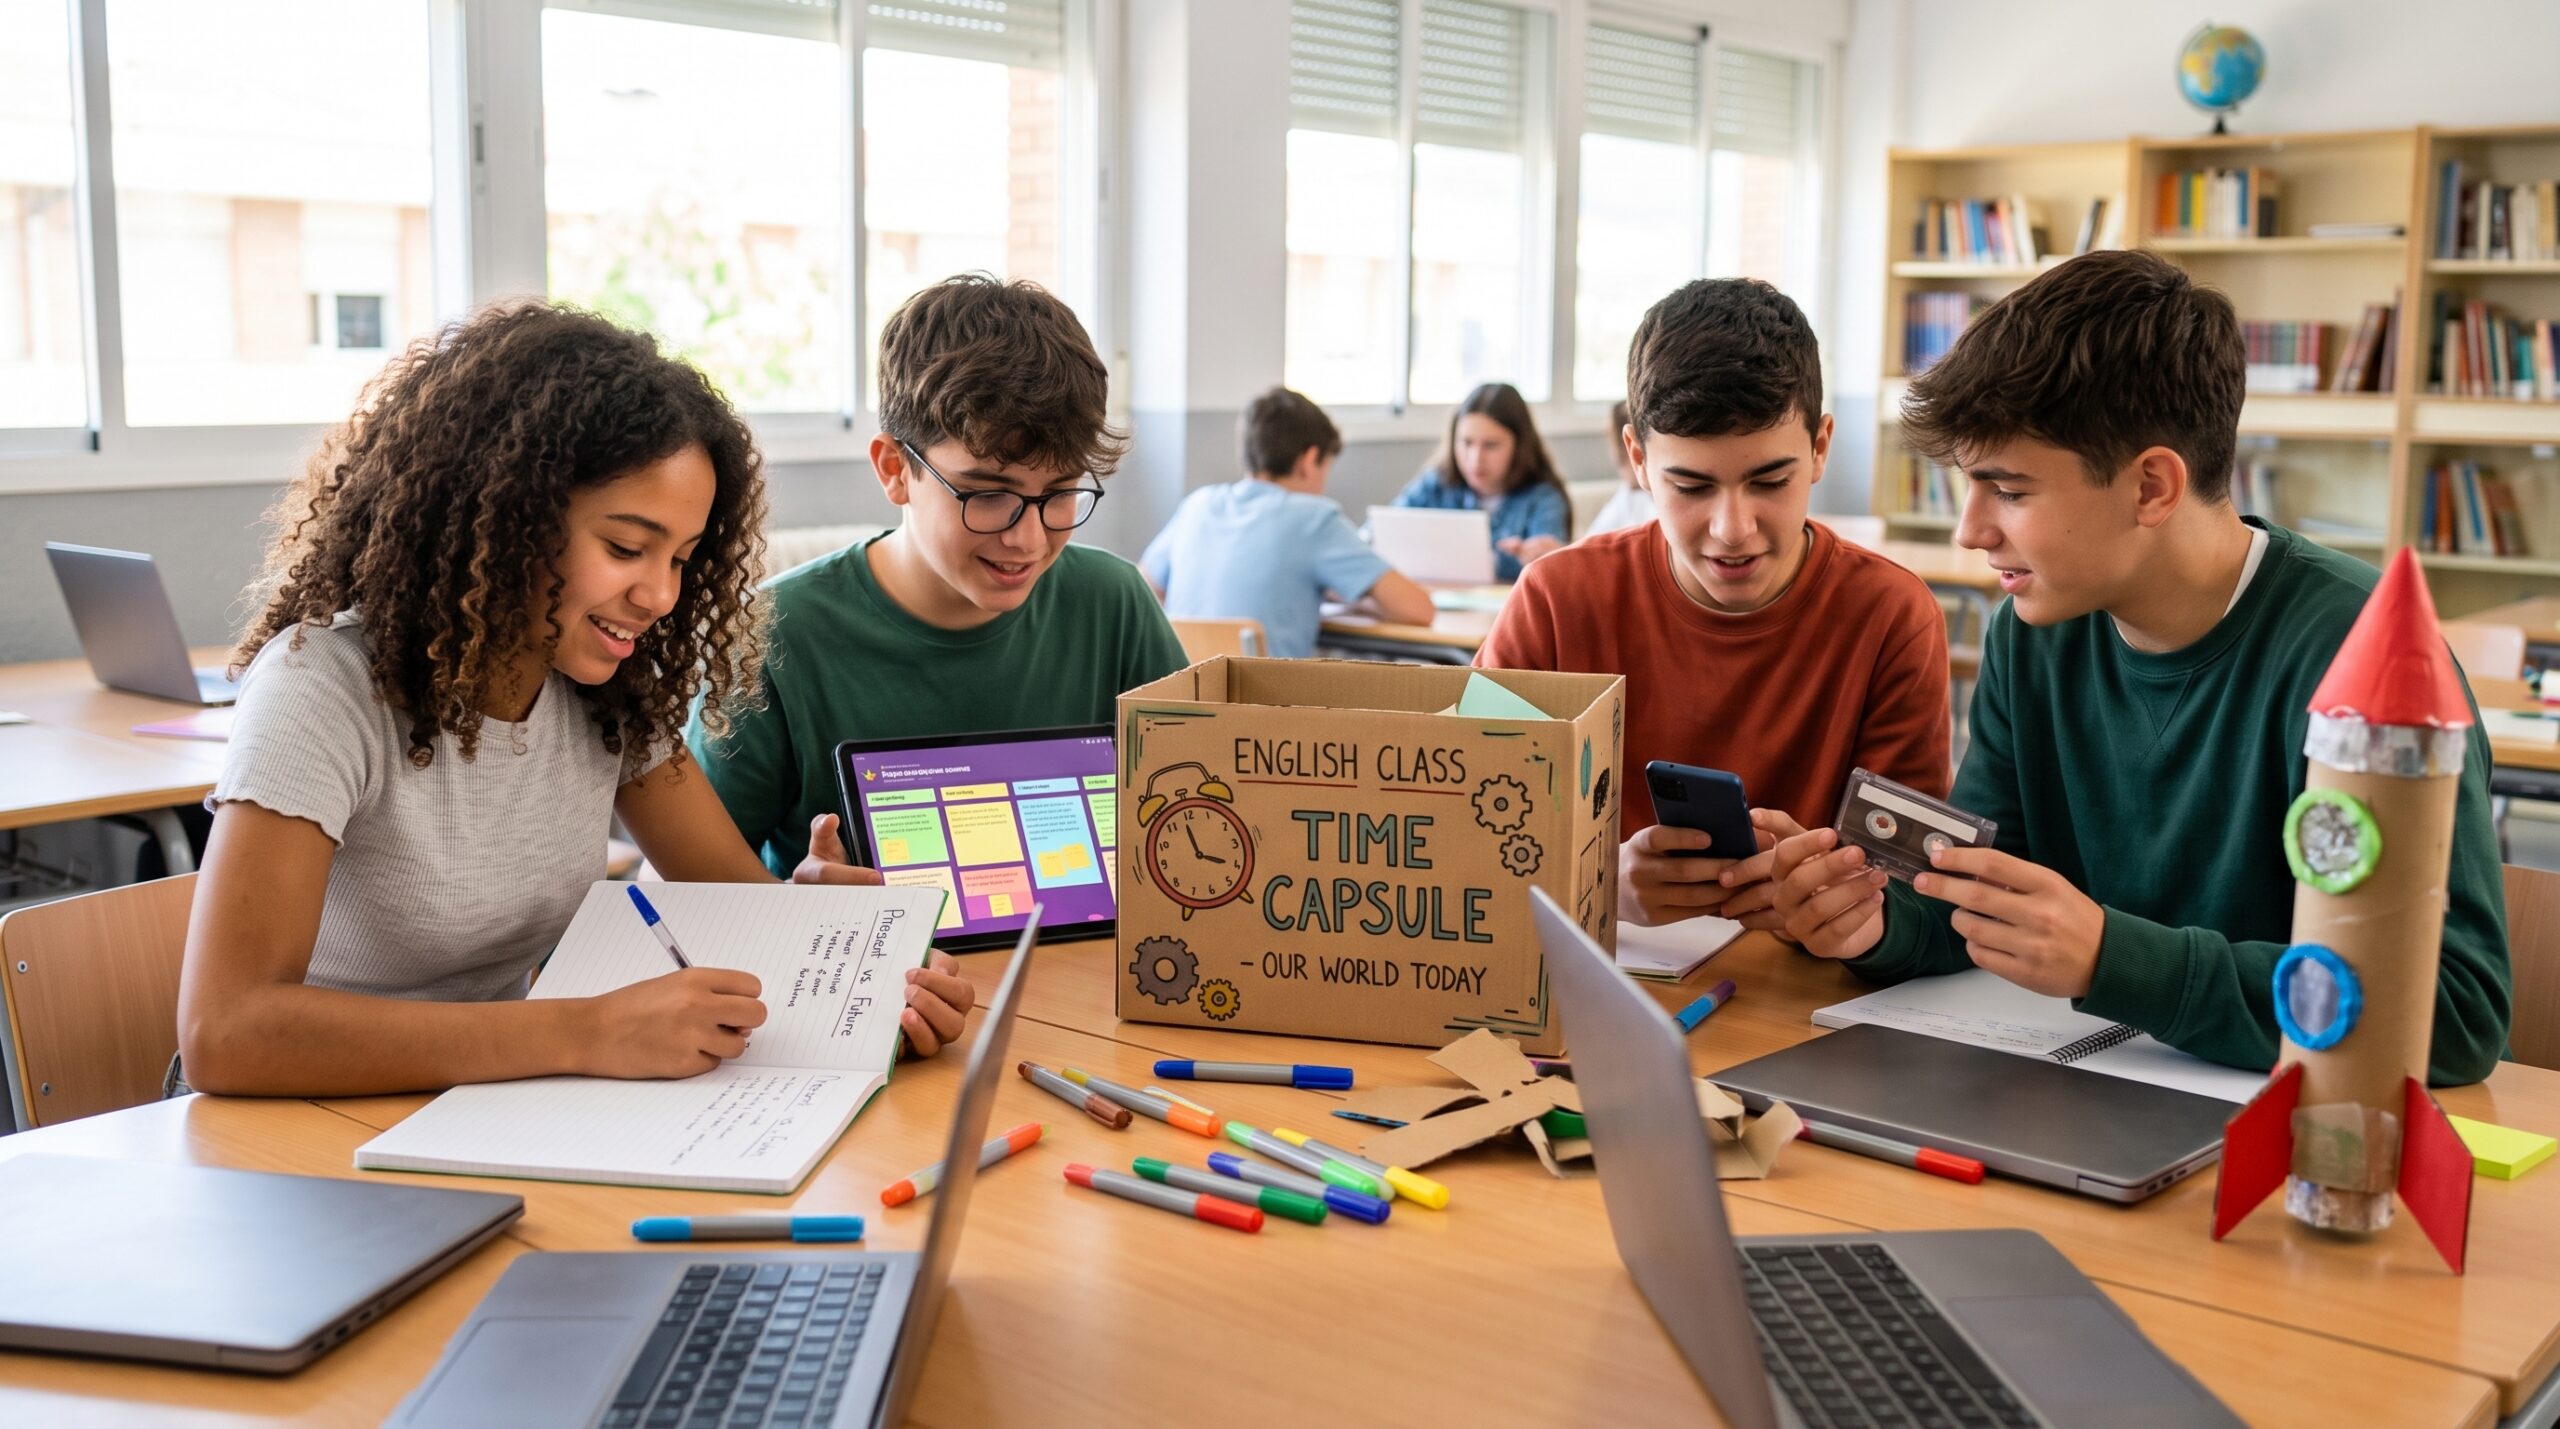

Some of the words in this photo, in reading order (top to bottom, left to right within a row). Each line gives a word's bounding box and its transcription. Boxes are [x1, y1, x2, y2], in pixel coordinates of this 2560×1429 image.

[1235, 737, 1358, 780] ENGLISH
[1377, 745, 1466, 784] CLASS
[1184, 810, 1194, 820] 12
[1167, 822, 1177, 833] 11
[1222, 822, 1228, 832] 2
[1231, 838, 1239, 849] 3
[1291, 809, 1434, 870] TIME
[1160, 841, 1169, 851] 10
[1161, 859, 1168, 869] 9
[1234, 860, 1240, 870] 4
[1173, 877, 1179, 887] 8
[1226, 876, 1233, 887] 5
[1191, 887, 1196, 896] 7
[1209, 884, 1215, 895] 6
[1262, 875, 1493, 943] CAPSULE
[1262, 952, 1308, 980] OUR
[1319, 956, 1399, 987] WORLD
[1410, 962, 1487, 996] TODAY
[840, 997, 872, 1037] Future
